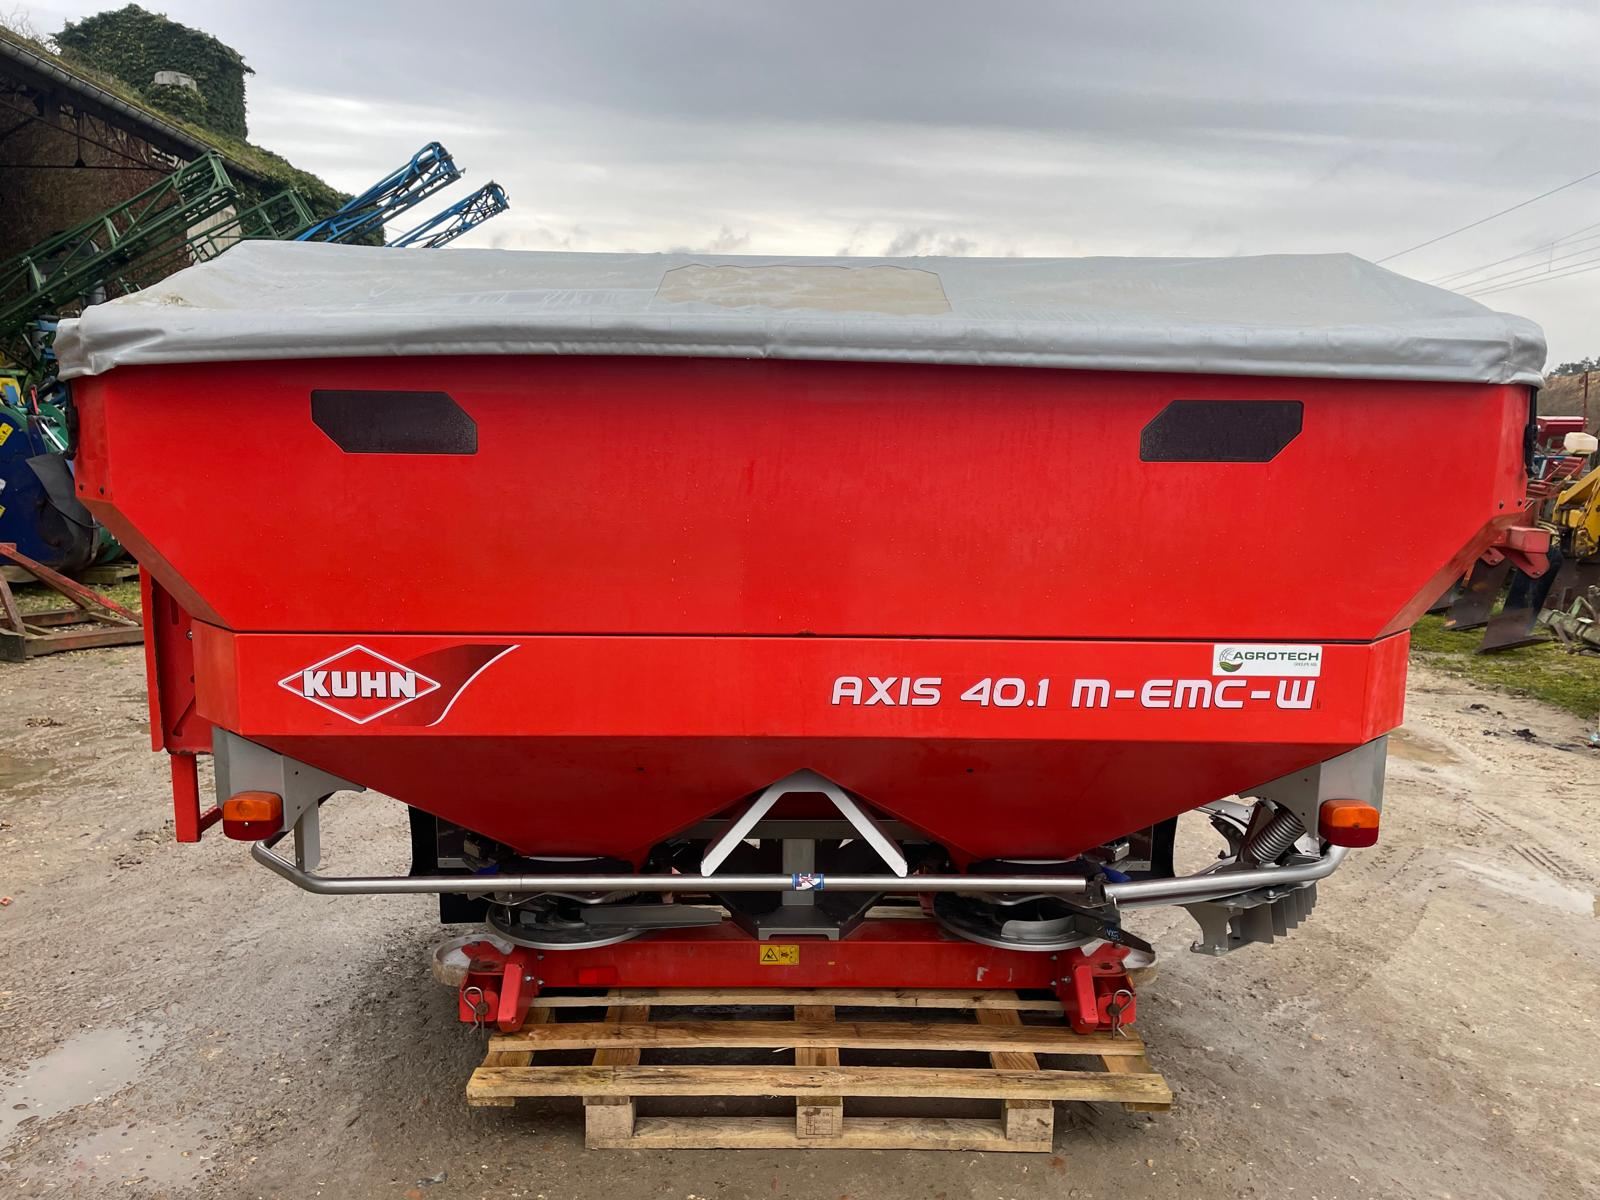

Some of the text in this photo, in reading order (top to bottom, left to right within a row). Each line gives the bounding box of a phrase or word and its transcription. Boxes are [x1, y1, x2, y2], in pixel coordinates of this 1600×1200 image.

[1233, 651, 1319, 661] AGROTECH
[303, 670, 416, 698] KUHN
[831, 676, 942, 706] AXIS
[960, 678, 1050, 707] 40.1
